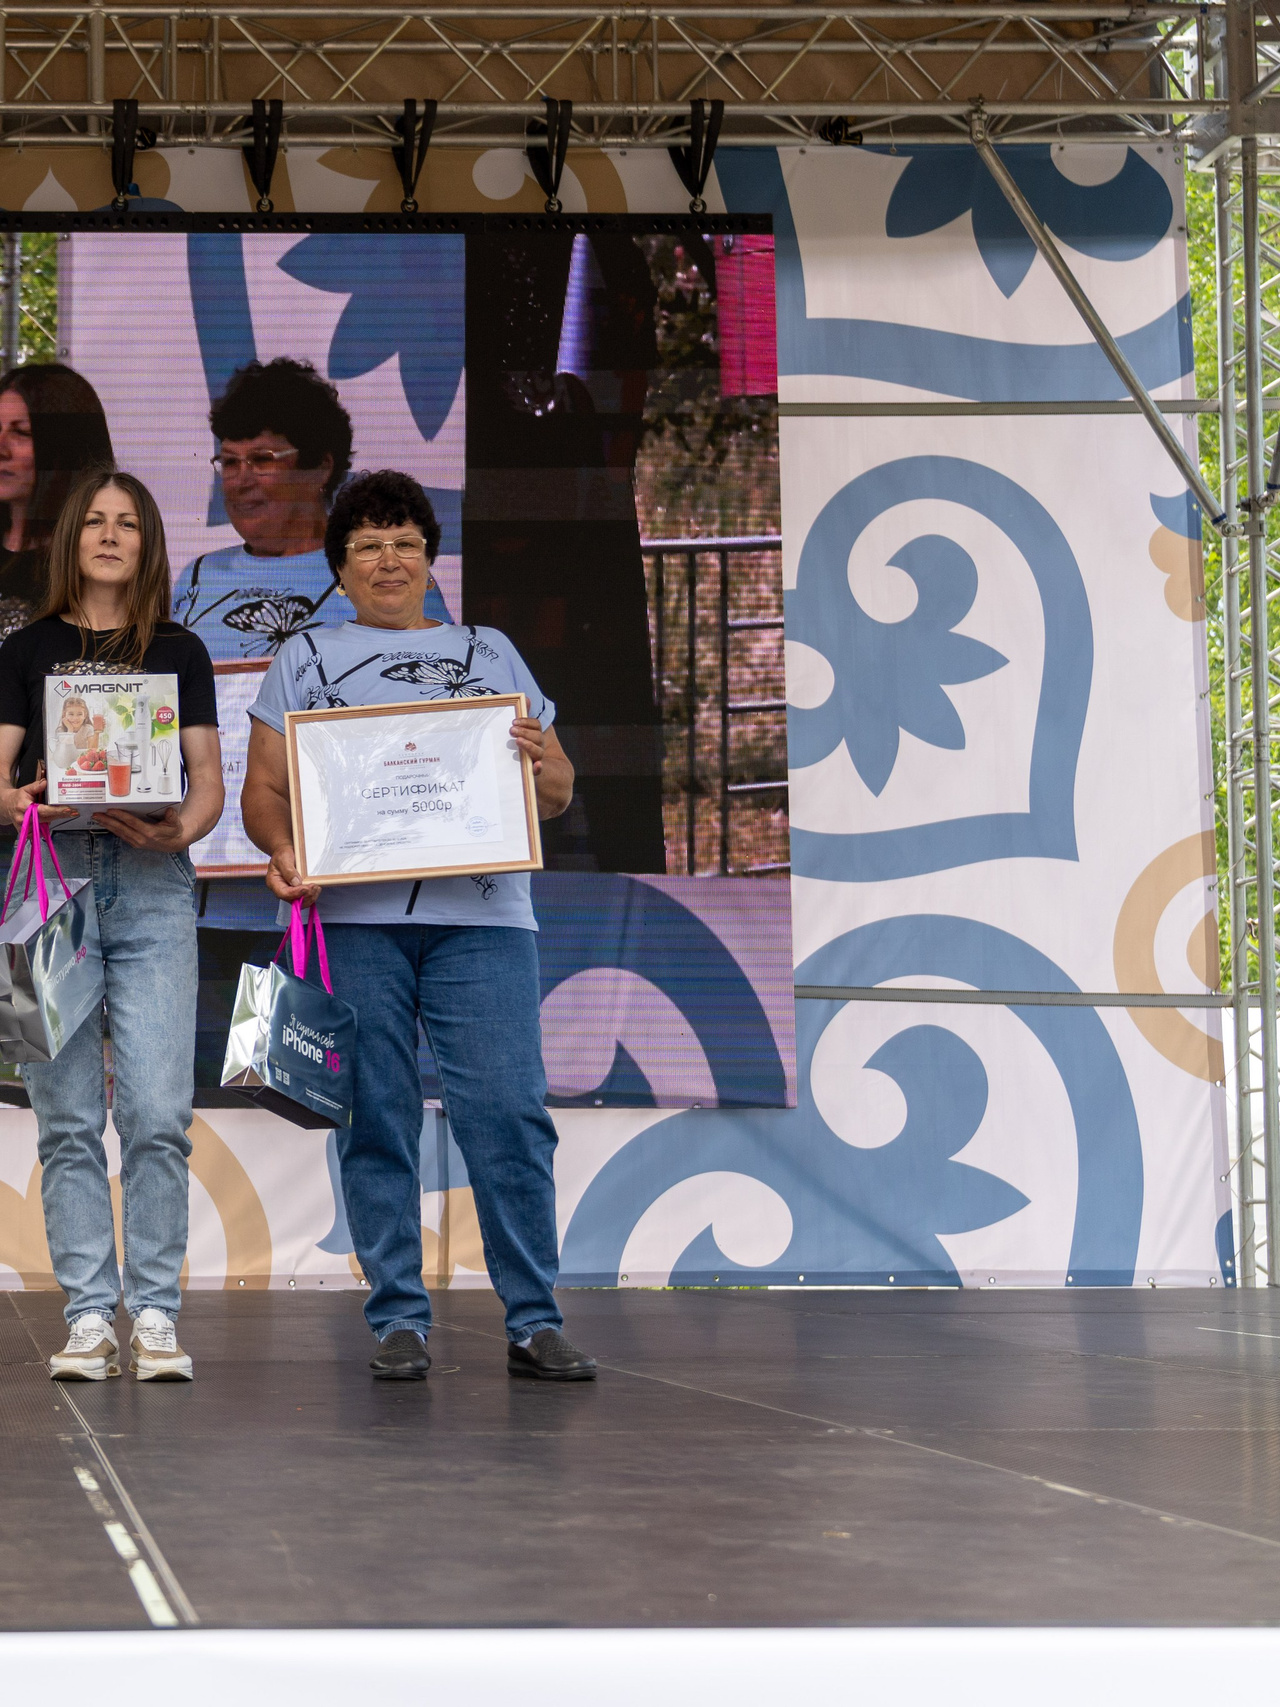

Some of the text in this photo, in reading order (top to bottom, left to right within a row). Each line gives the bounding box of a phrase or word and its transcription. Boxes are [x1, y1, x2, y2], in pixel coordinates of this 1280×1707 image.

[74, 682, 143, 694] MAGNIT
[158, 712, 172, 720] 450
[383, 758, 418, 767] БАЛКАНСКИЙ
[361, 780, 465, 799] СЕРТИФИКАТ
[387, 808, 409, 816] сумму
[412, 800, 452, 812] 5000р
[289, 1013, 297, 1030] Я
[320, 1033, 336, 1049] себе
[282, 1024, 341, 1073] iPhone 16
